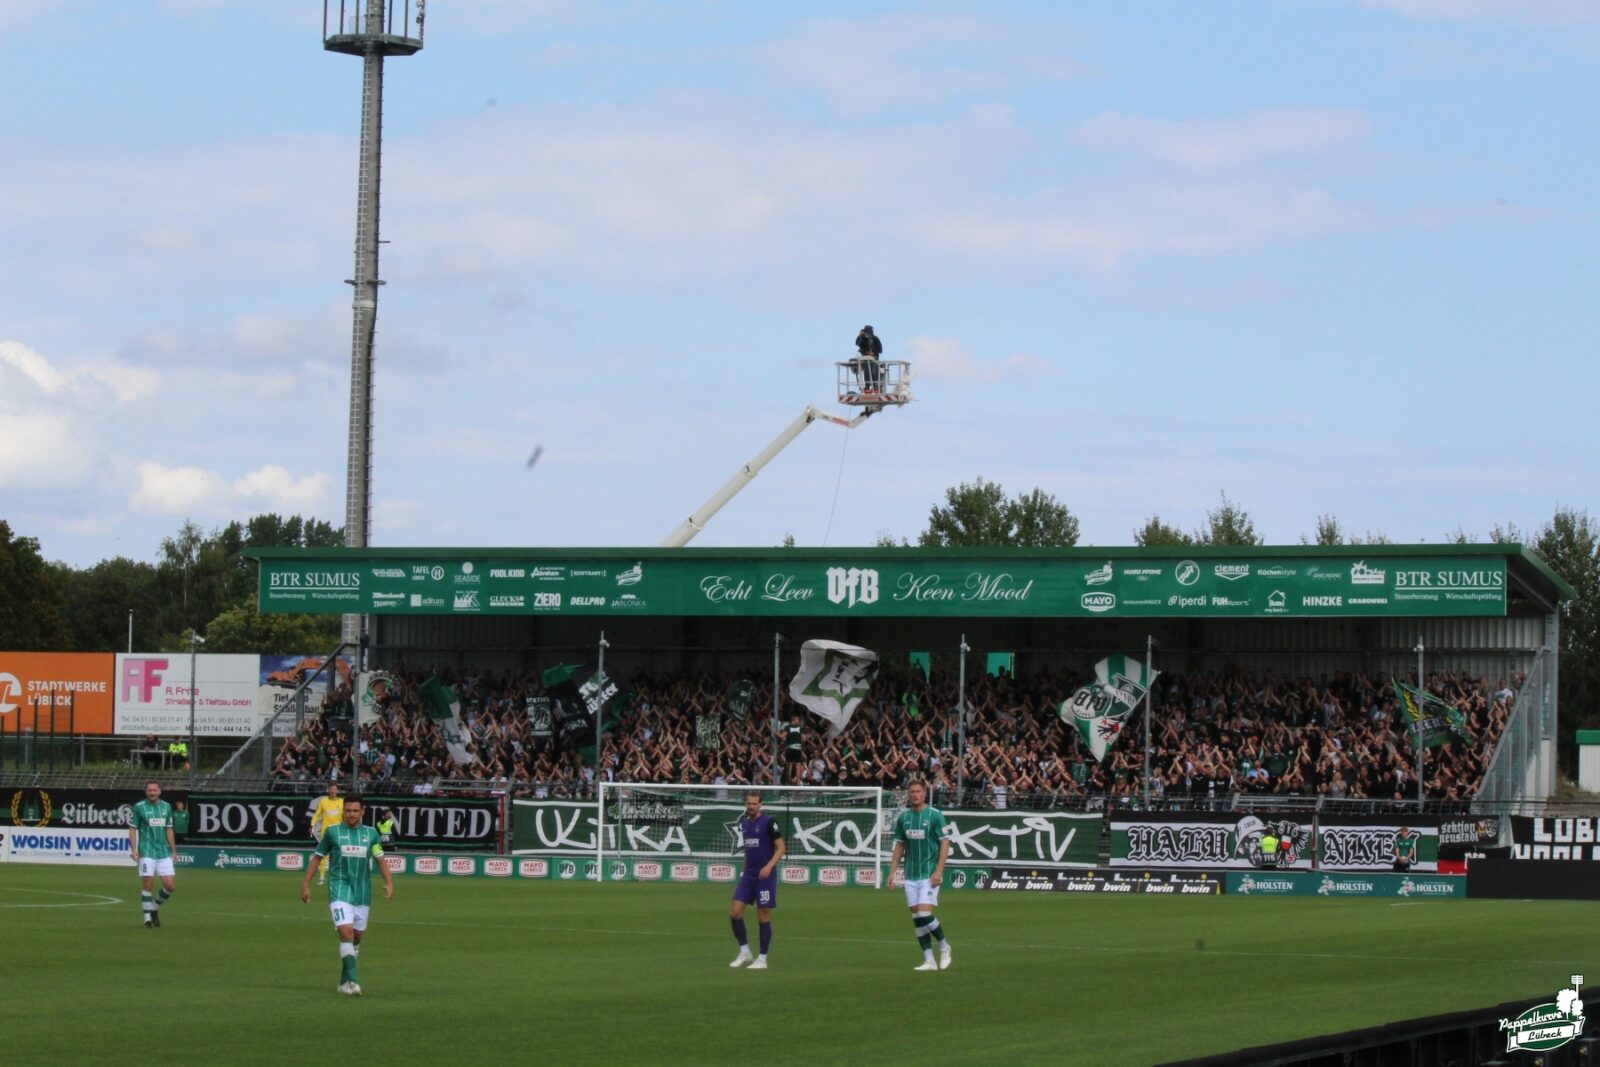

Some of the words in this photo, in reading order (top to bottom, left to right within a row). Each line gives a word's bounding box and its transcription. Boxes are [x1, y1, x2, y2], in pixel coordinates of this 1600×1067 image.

[1214, 564, 1249, 572] clement
[270, 573, 301, 586] BTR
[305, 572, 360, 586] SUMUS
[1395, 572, 1432, 586] BTR
[1437, 571, 1503, 586] SUMUS
[700, 575, 752, 603] Echt
[893, 572, 955, 601] Keen
[961, 572, 1034, 601] Mood
[570, 597, 605, 605] DELLPRO
[1084, 597, 1111, 605] MAYO
[1178, 596, 1207, 608] iperdi
[1303, 597, 1342, 606] HINZKE
[28, 681, 107, 692] STADTWERKE
[197, 803, 294, 834] BOYS
[12, 835, 71, 850] WOISIN
[990, 880, 1018, 889] bwin
[1025, 881, 1053, 890] bwin
[1067, 881, 1095, 891] bwin
[1103, 882, 1131, 892] bwin
[1146, 882, 1174, 893] bwin
[1181, 883, 1210, 894] bwin
[1257, 881, 1294, 890] HOLSTEN
[1336, 882, 1373, 892] HOLSTEN
[1417, 883, 1454, 893] HOLSTEN
[760, 890, 770, 901] 30
[334, 908, 345, 921] 31
